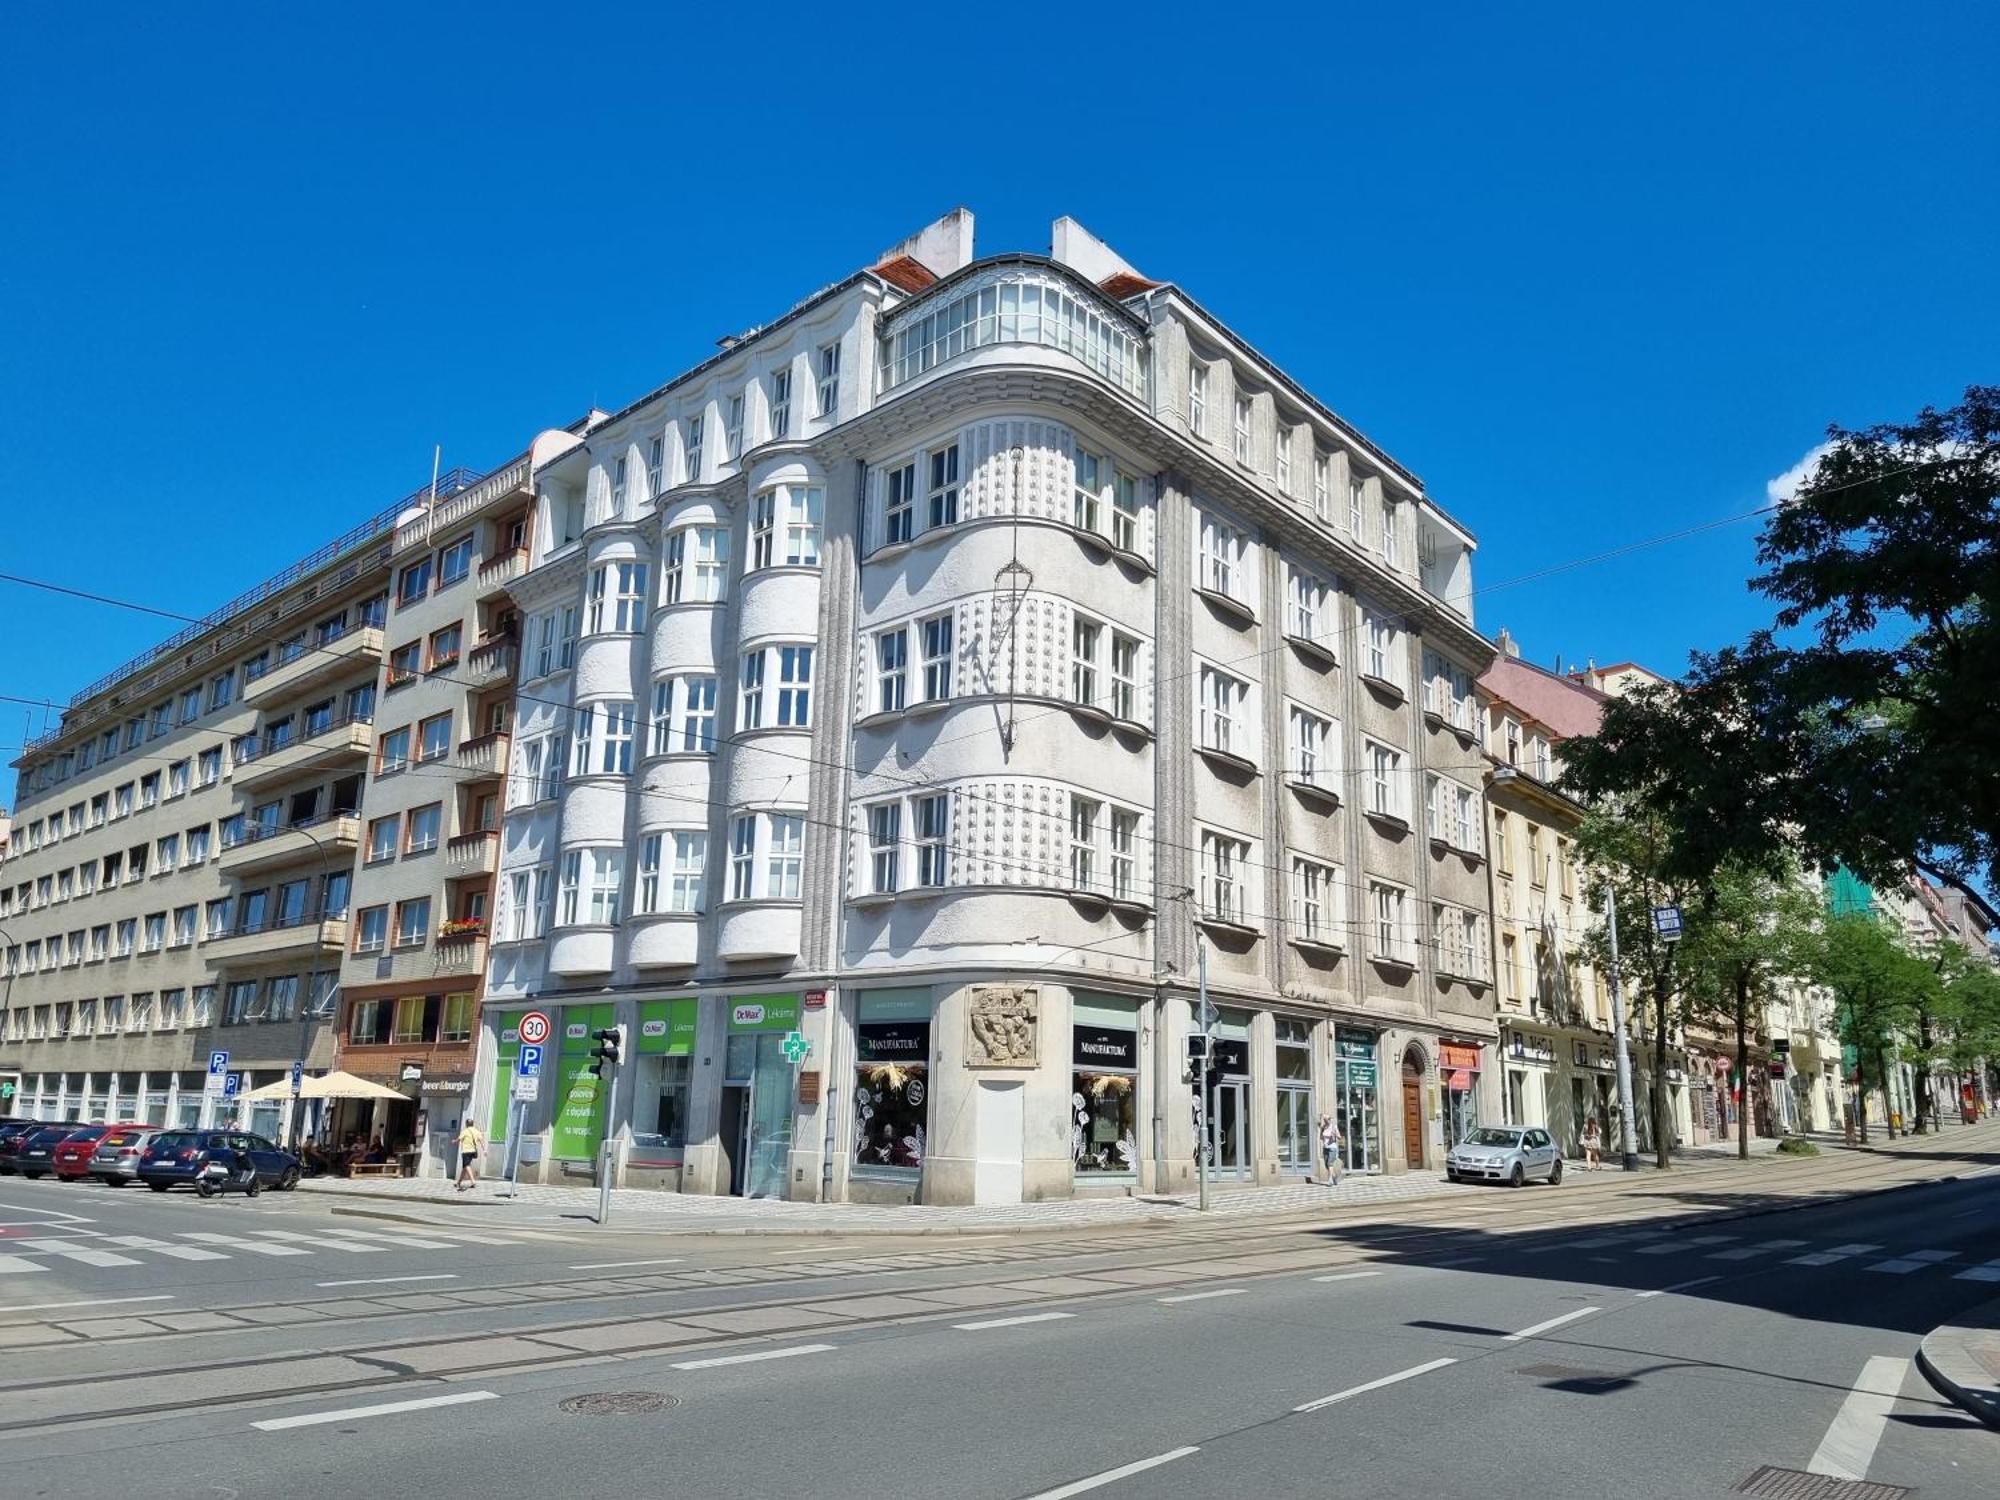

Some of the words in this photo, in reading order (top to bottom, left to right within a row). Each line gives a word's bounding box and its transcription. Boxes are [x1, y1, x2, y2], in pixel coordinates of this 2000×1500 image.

[526, 1021, 544, 1036] 30
[868, 1039, 919, 1050] MANUFAKTURA
[1081, 1041, 1127, 1057] MANUFAKTURA
[213, 1054, 225, 1068] P
[524, 1048, 538, 1067] P
[227, 1077, 236, 1090] P
